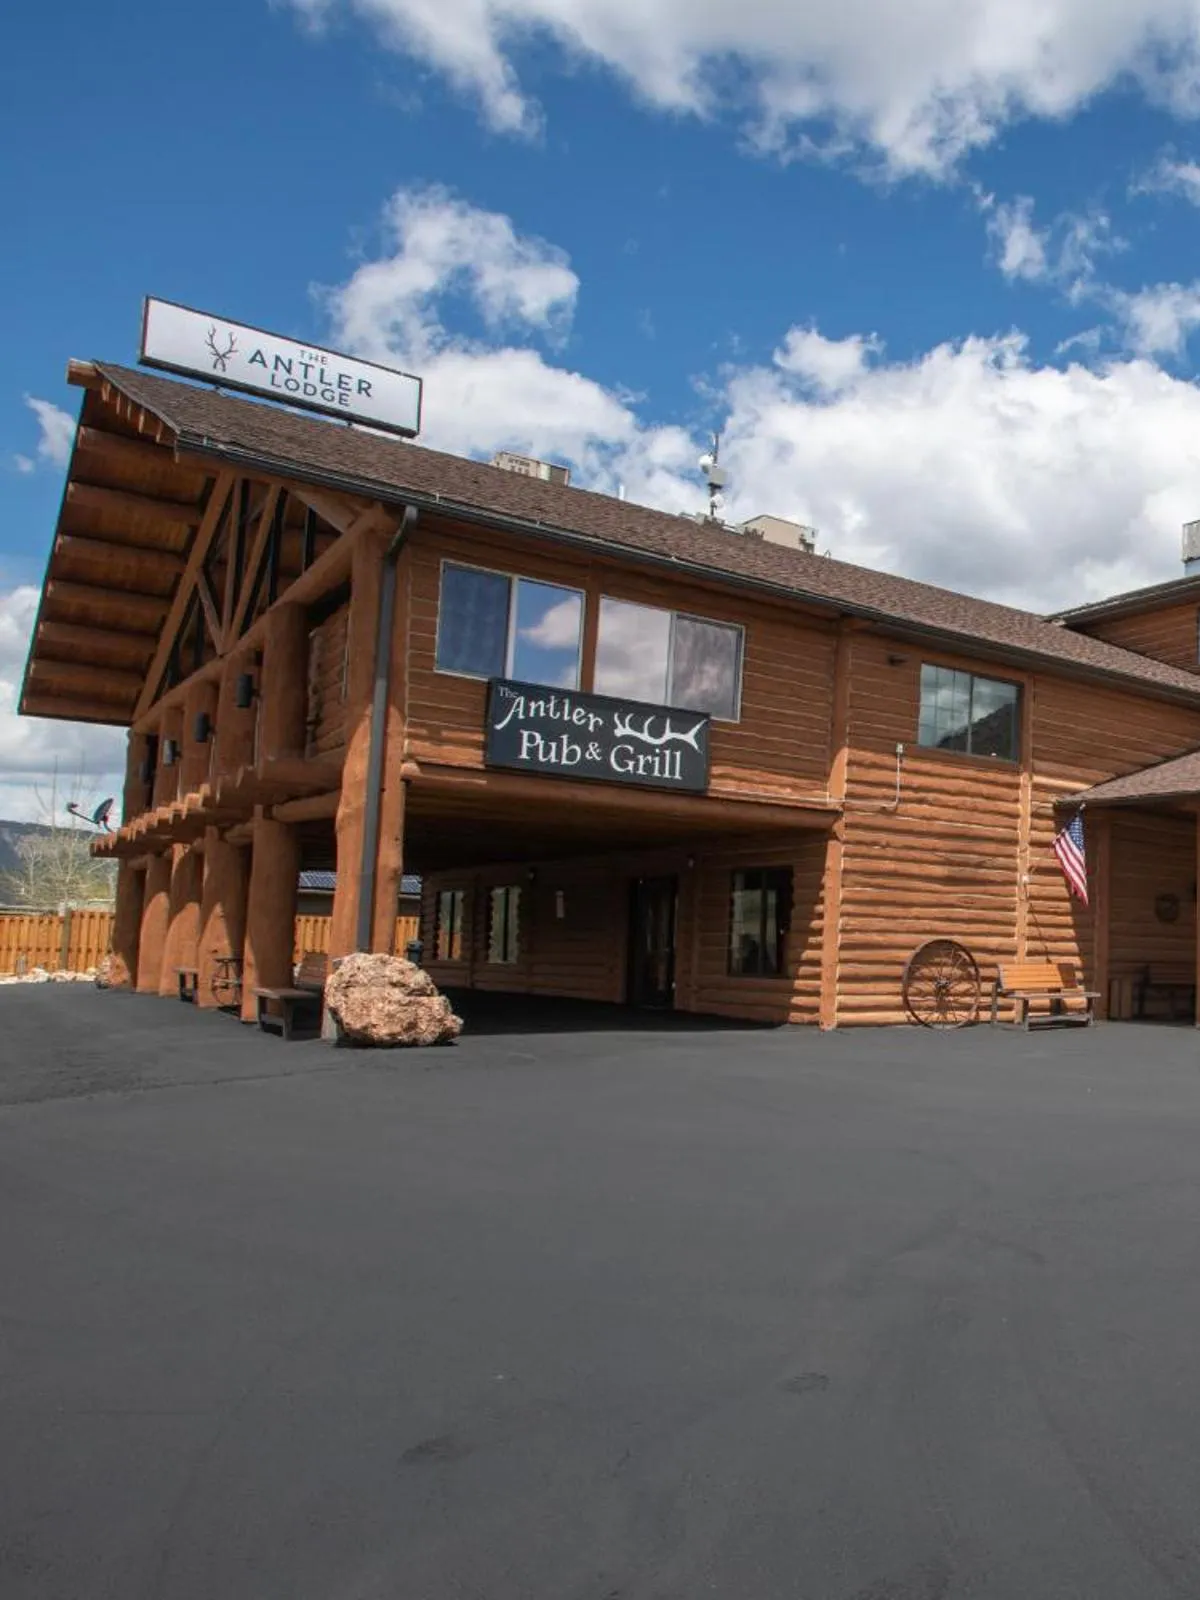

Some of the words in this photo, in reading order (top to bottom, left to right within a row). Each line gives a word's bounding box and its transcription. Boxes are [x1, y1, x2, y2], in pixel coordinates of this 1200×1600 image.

[248, 349, 373, 398] ANTLER
[300, 350, 328, 366] THE
[271, 373, 351, 407] LODGE
[498, 685, 519, 698] The
[494, 695, 604, 733] Antler
[519, 729, 582, 766] Pub
[585, 742, 603, 761] &
[610, 744, 683, 780] Grill
